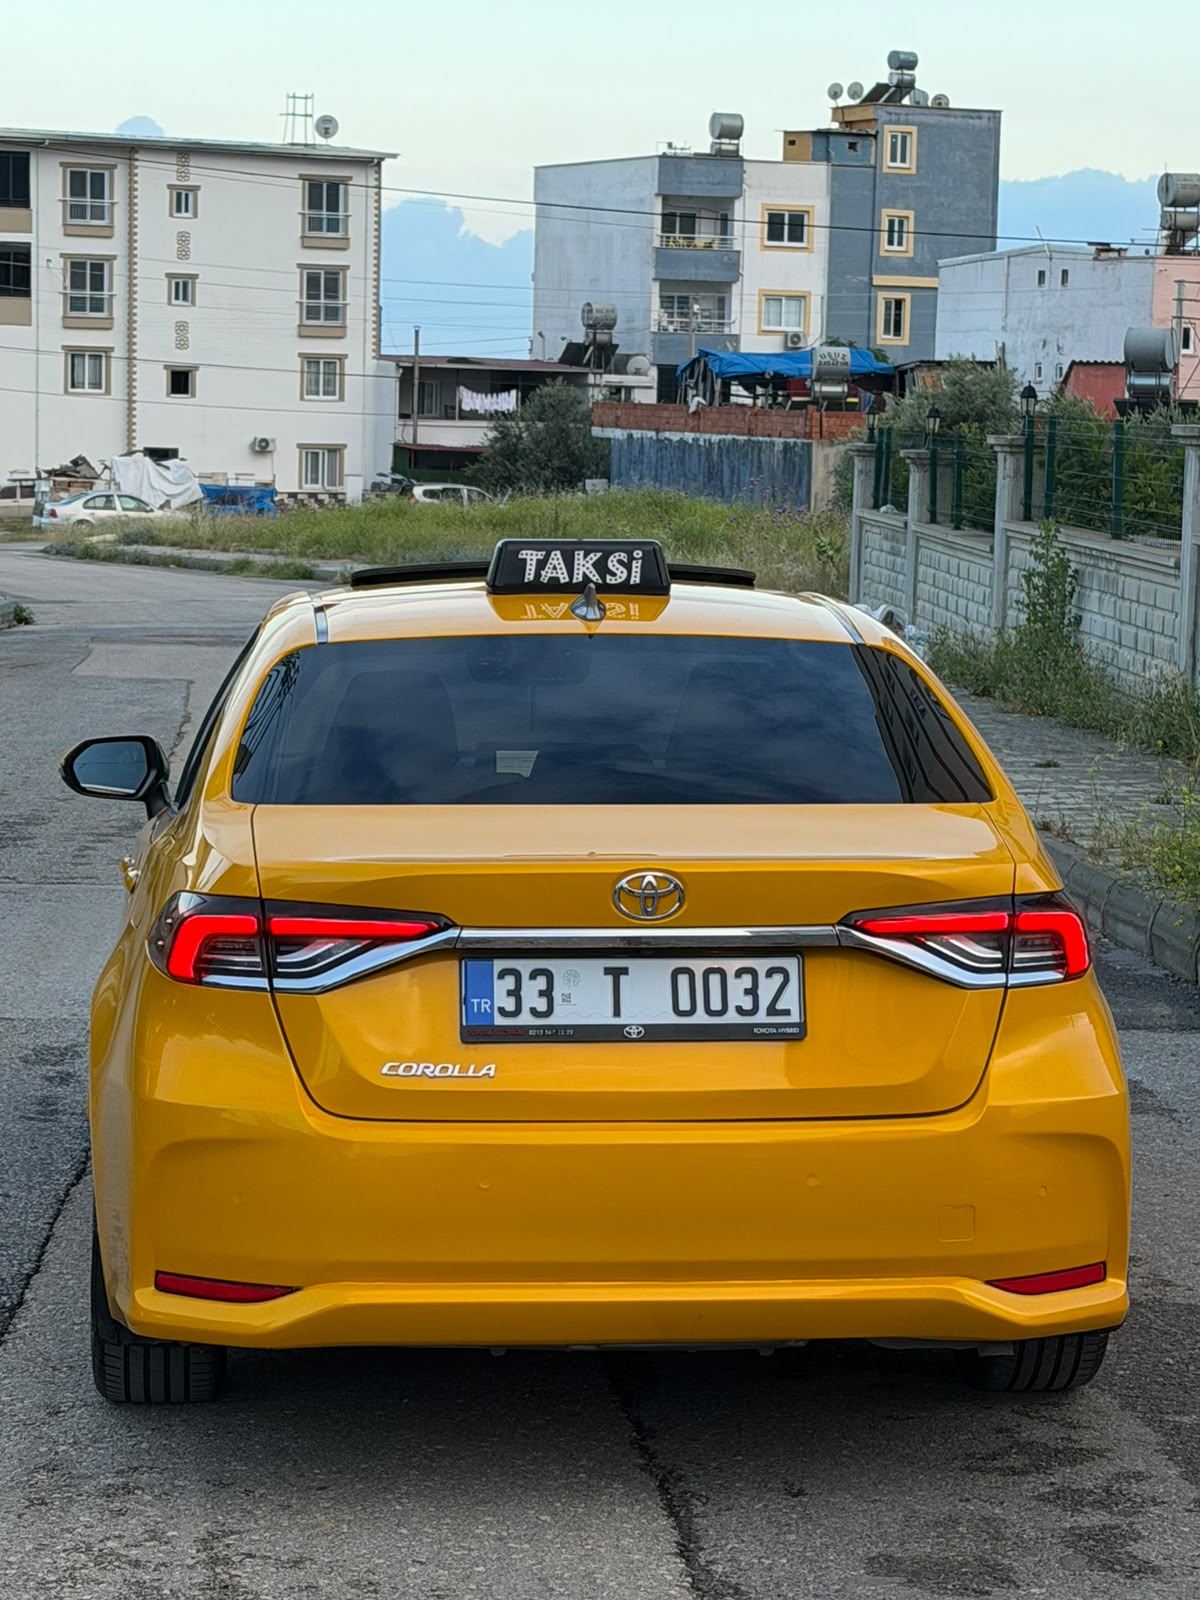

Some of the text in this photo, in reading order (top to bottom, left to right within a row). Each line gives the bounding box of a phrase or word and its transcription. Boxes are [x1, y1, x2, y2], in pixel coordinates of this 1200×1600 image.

[471, 966, 791, 1018] TR 33 T 0032
[381, 1062, 496, 1078] COROLLA
